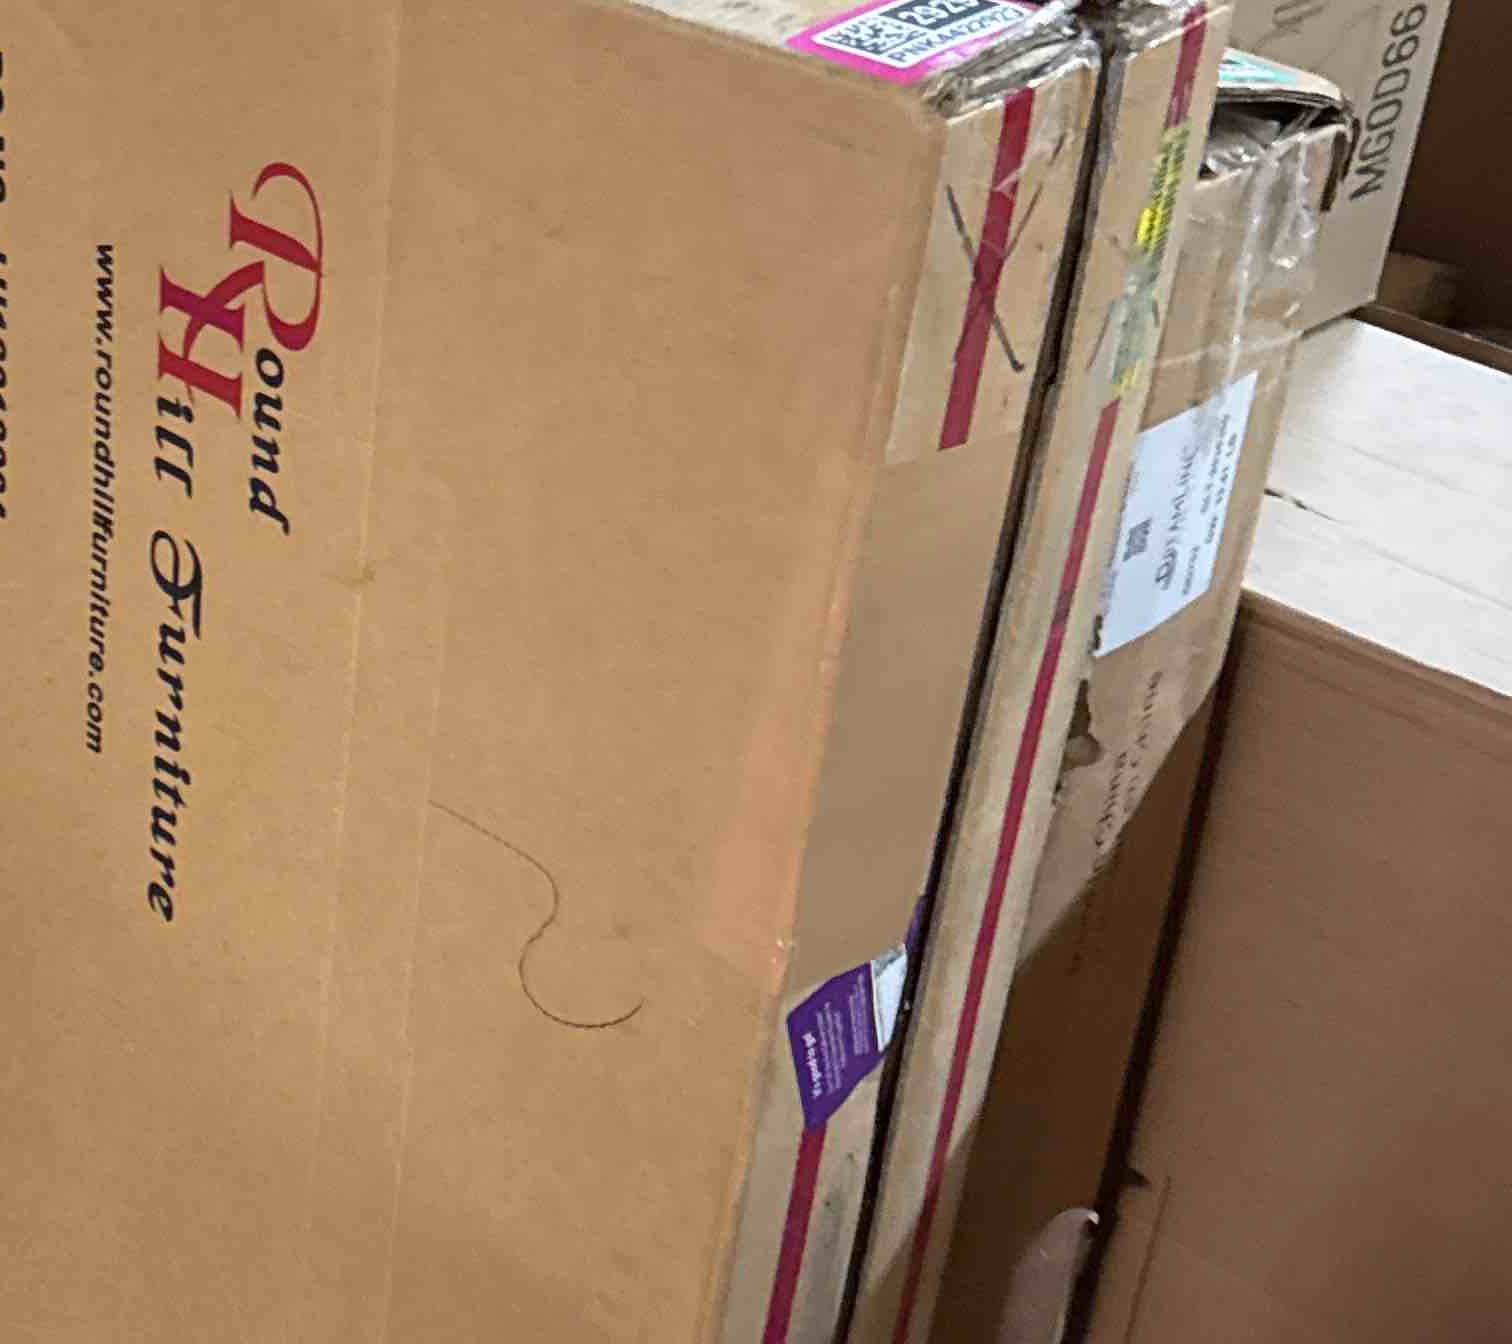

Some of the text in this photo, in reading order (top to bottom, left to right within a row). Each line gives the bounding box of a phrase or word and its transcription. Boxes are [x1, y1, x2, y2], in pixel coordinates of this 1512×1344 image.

[86, 244, 115, 753] www.roundhillfurniture.com
[228, 162, 324, 535] Round
[148, 529, 203, 924] Furniture
